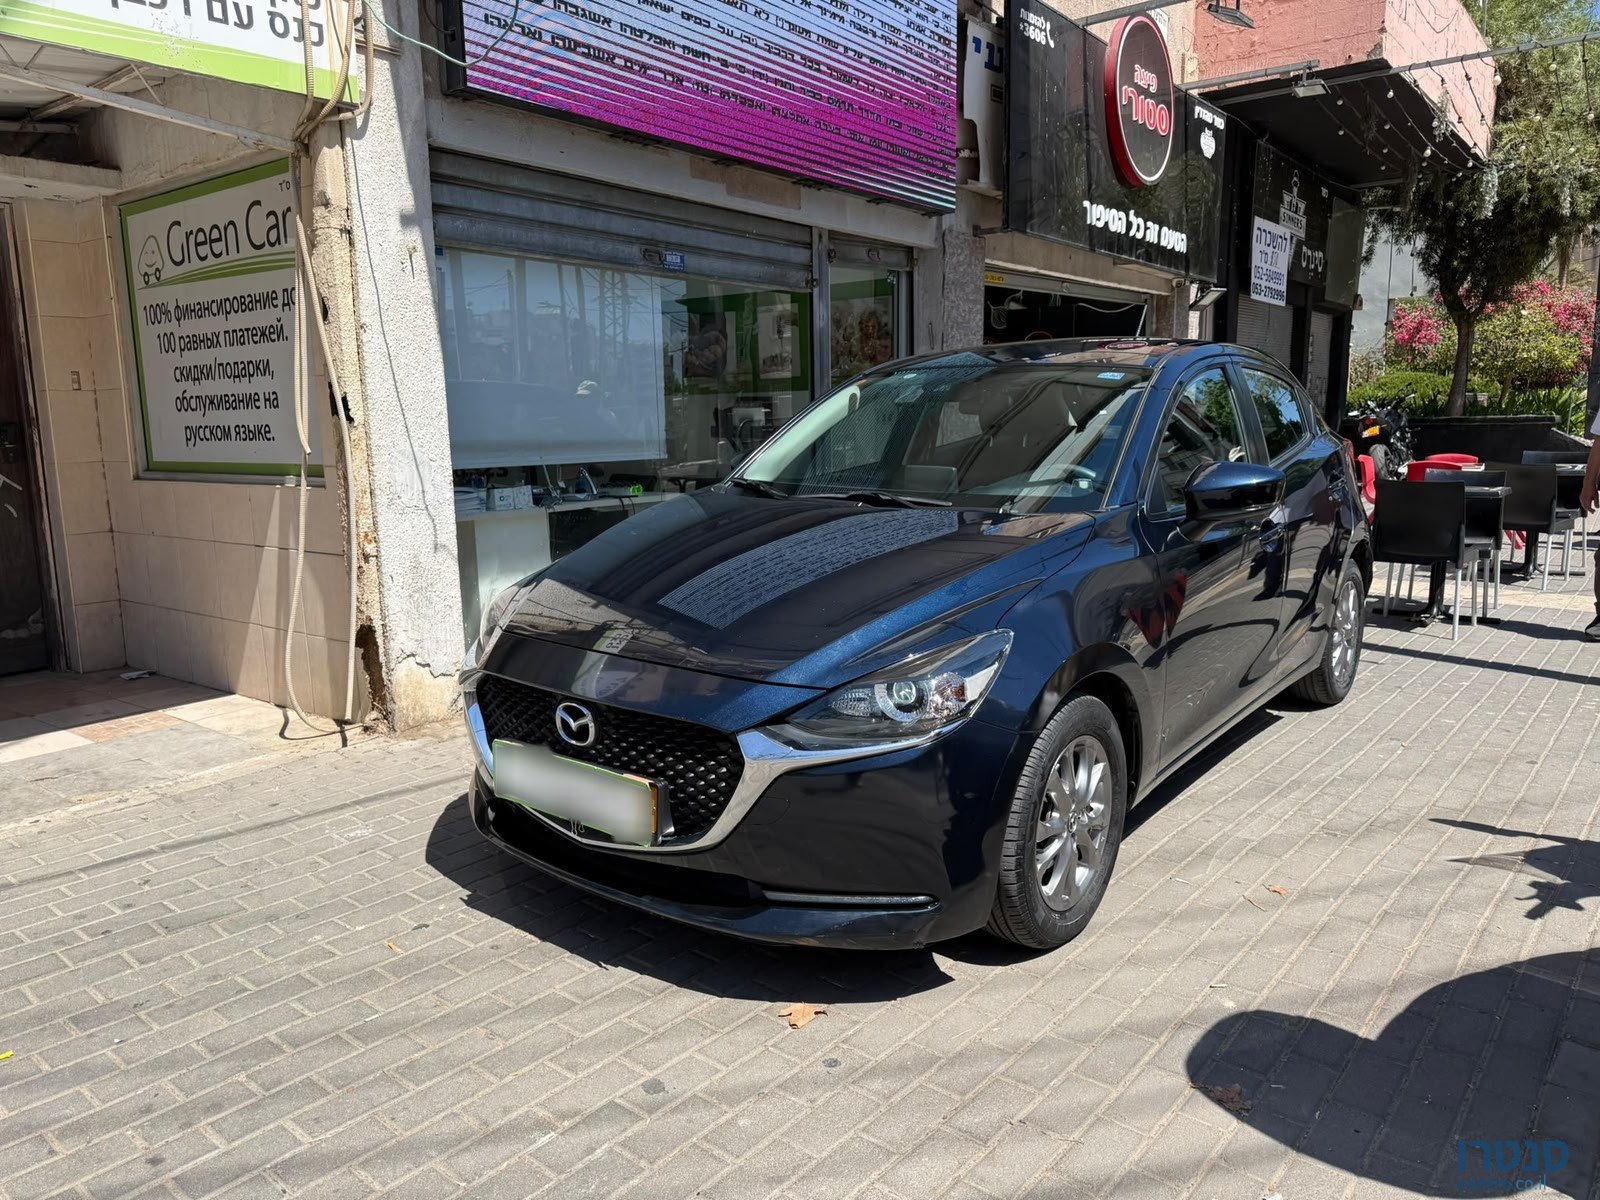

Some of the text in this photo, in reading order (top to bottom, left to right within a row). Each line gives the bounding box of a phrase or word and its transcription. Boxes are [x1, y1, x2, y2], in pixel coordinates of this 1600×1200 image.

[1134, 64, 1158, 93] פיצה
[1122, 86, 1170, 136] סטורי
[166, 200, 292, 268] Green Car
[1082, 200, 1187, 254] הטעם זה כל הסיפור
[1256, 226, 1288, 254] להשכרה
[143, 301, 172, 326] 100%
[173, 292, 279, 329] финансирование
[156, 317, 289, 358] 100 равных платежей.
[173, 356, 275, 388] скидки/подарки,
[174, 390, 280, 418] обслуживание на
[184, 424, 276, 448] русском языке.
